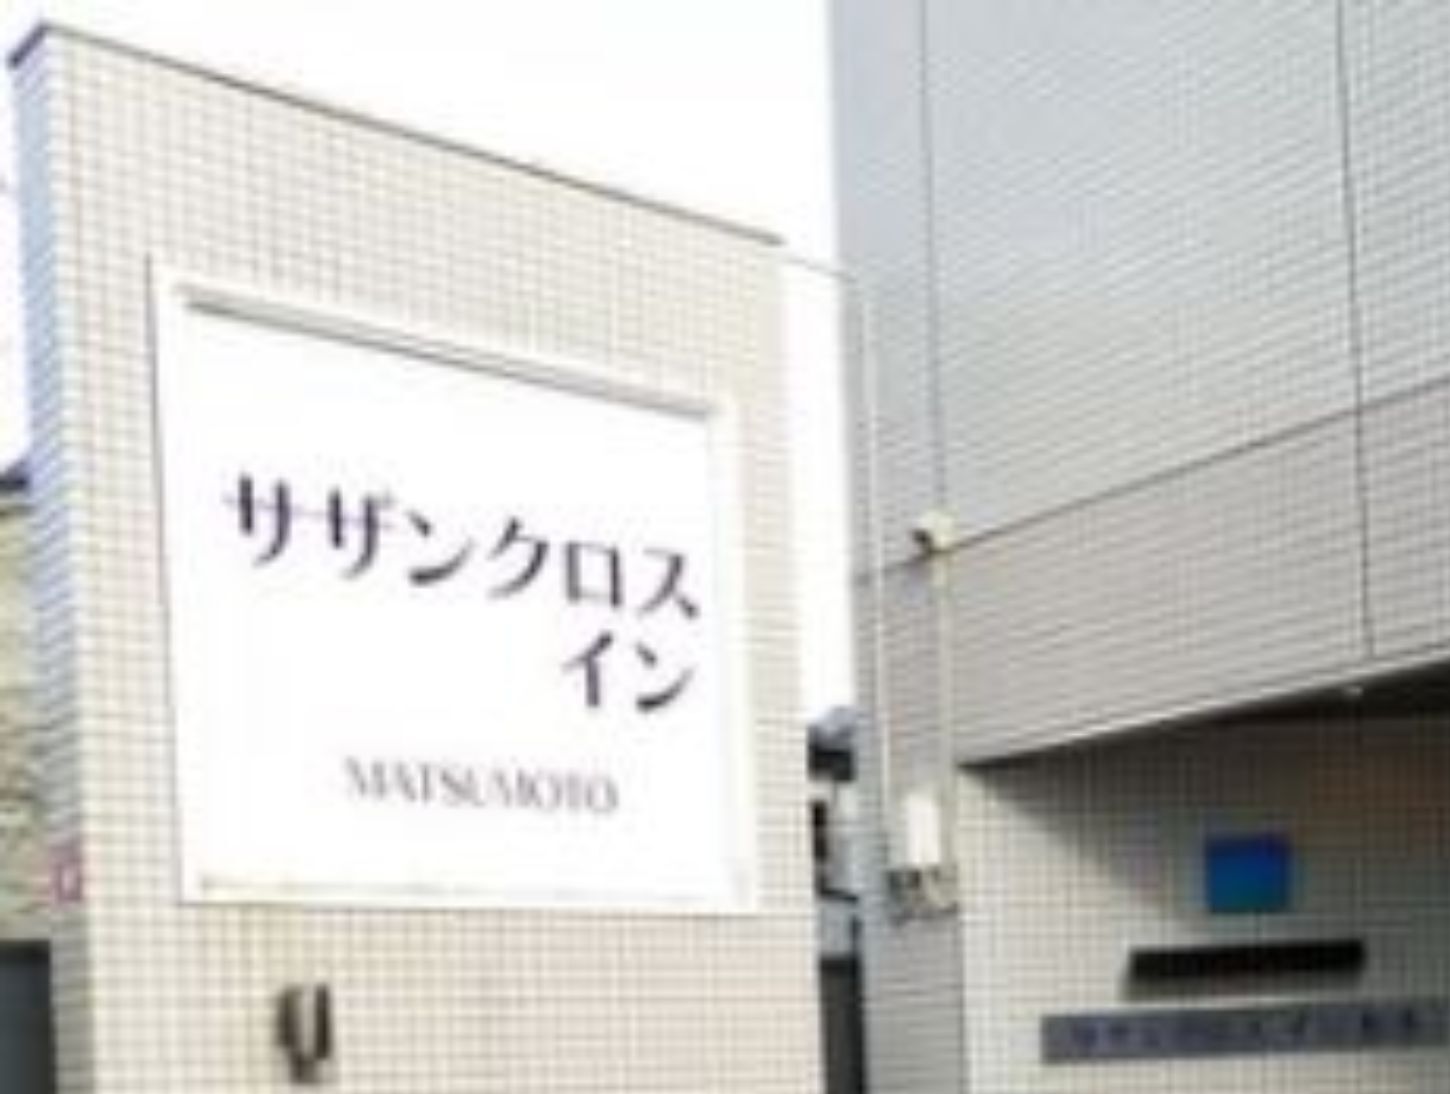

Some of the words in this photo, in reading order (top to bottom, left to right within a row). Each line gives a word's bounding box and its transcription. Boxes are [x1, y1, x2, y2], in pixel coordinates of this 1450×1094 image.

[223, 471, 700, 620] サザンクロス
[562, 630, 694, 715] イン
[345, 757, 620, 815] MATSUMOTO
